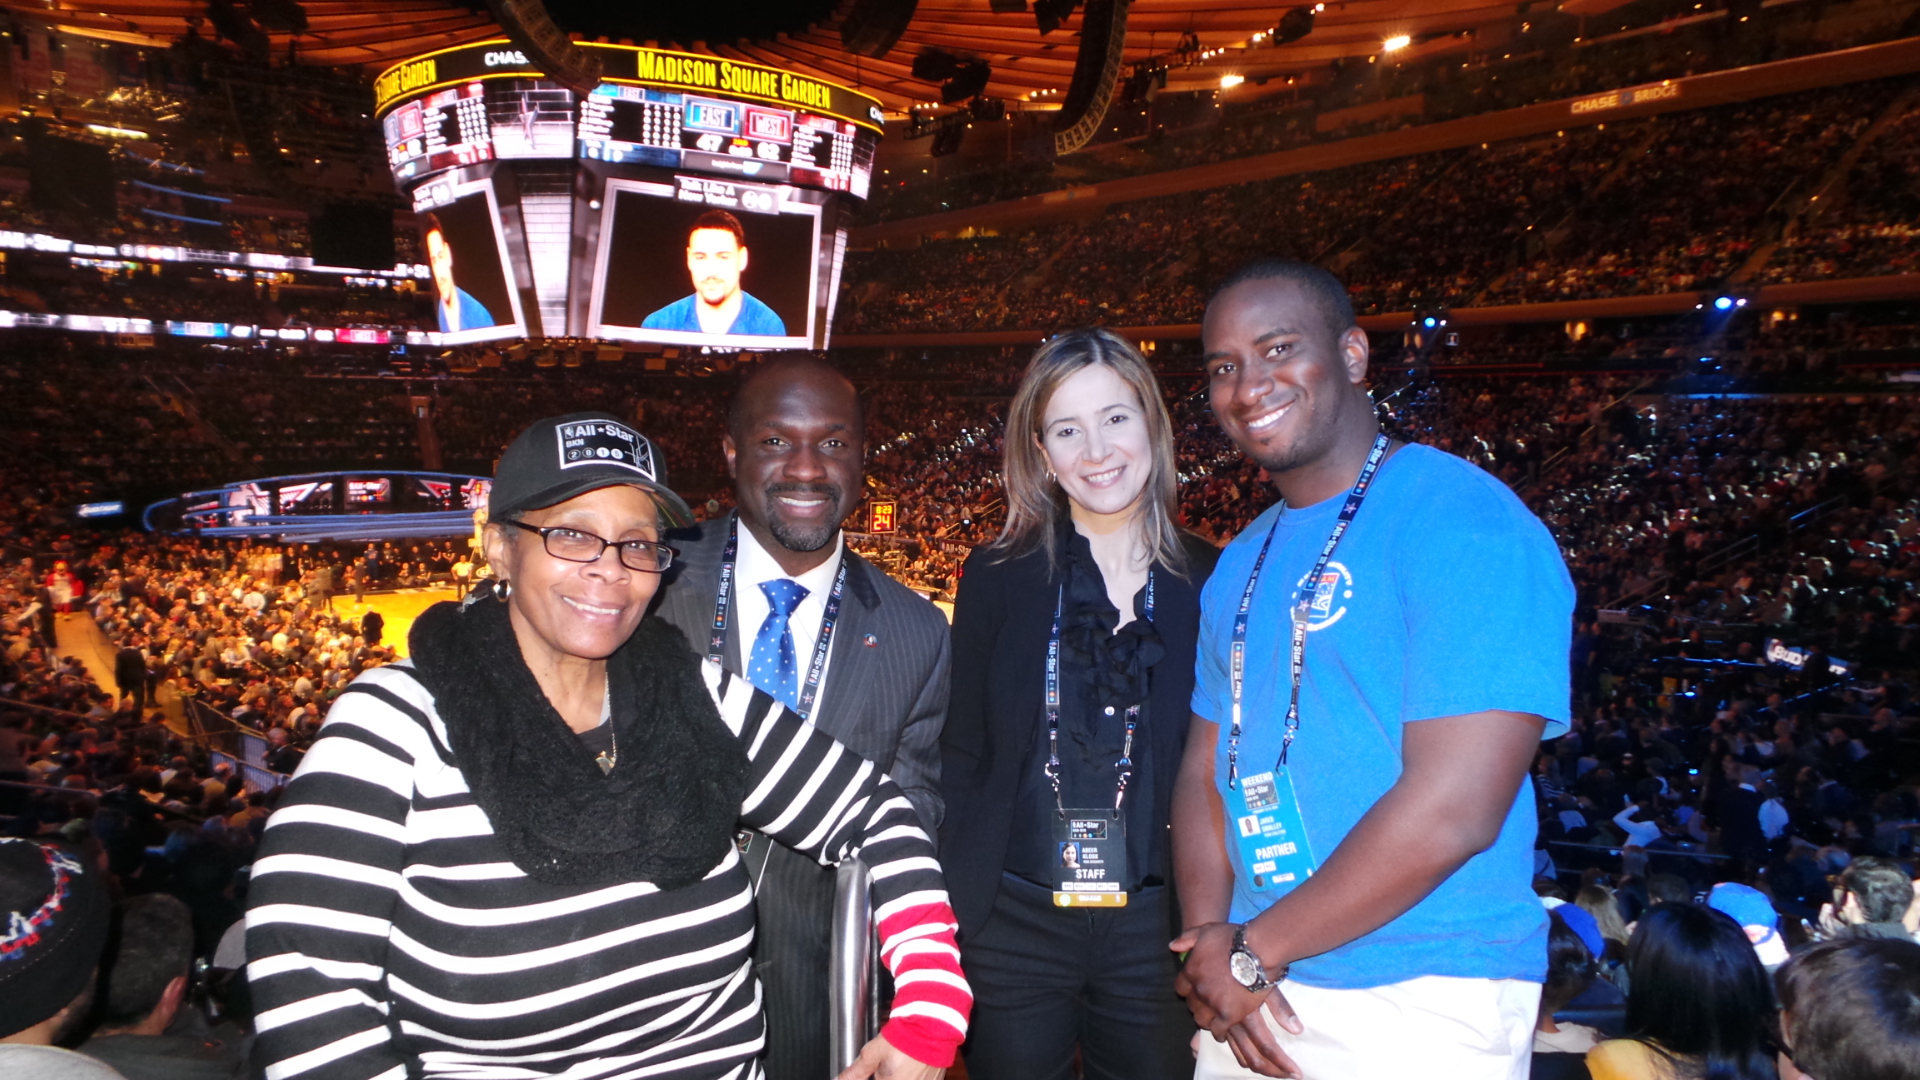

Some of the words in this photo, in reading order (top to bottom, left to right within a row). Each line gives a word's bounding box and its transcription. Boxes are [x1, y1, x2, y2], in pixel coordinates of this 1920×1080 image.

[485, 51, 530, 66] CHAS
[1571, 95, 1618, 114] CHASE
[1634, 84, 1678, 102] BRIDGE
[701, 105, 727, 131] EAST
[756, 115, 782, 136] WEST
[726, 185, 736, 196] A
[575, 425, 595, 437] All
[605, 424, 634, 443] Star
[566, 439, 584, 449] BKN
[876, 505, 892, 515] 8:23
[874, 515, 890, 530] 24
[1294, 628, 1303, 641] All
[1240, 771, 1274, 787] WEEKEND
[1255, 842, 1297, 861] PARTNER
[1075, 869, 1106, 879] STAFF
